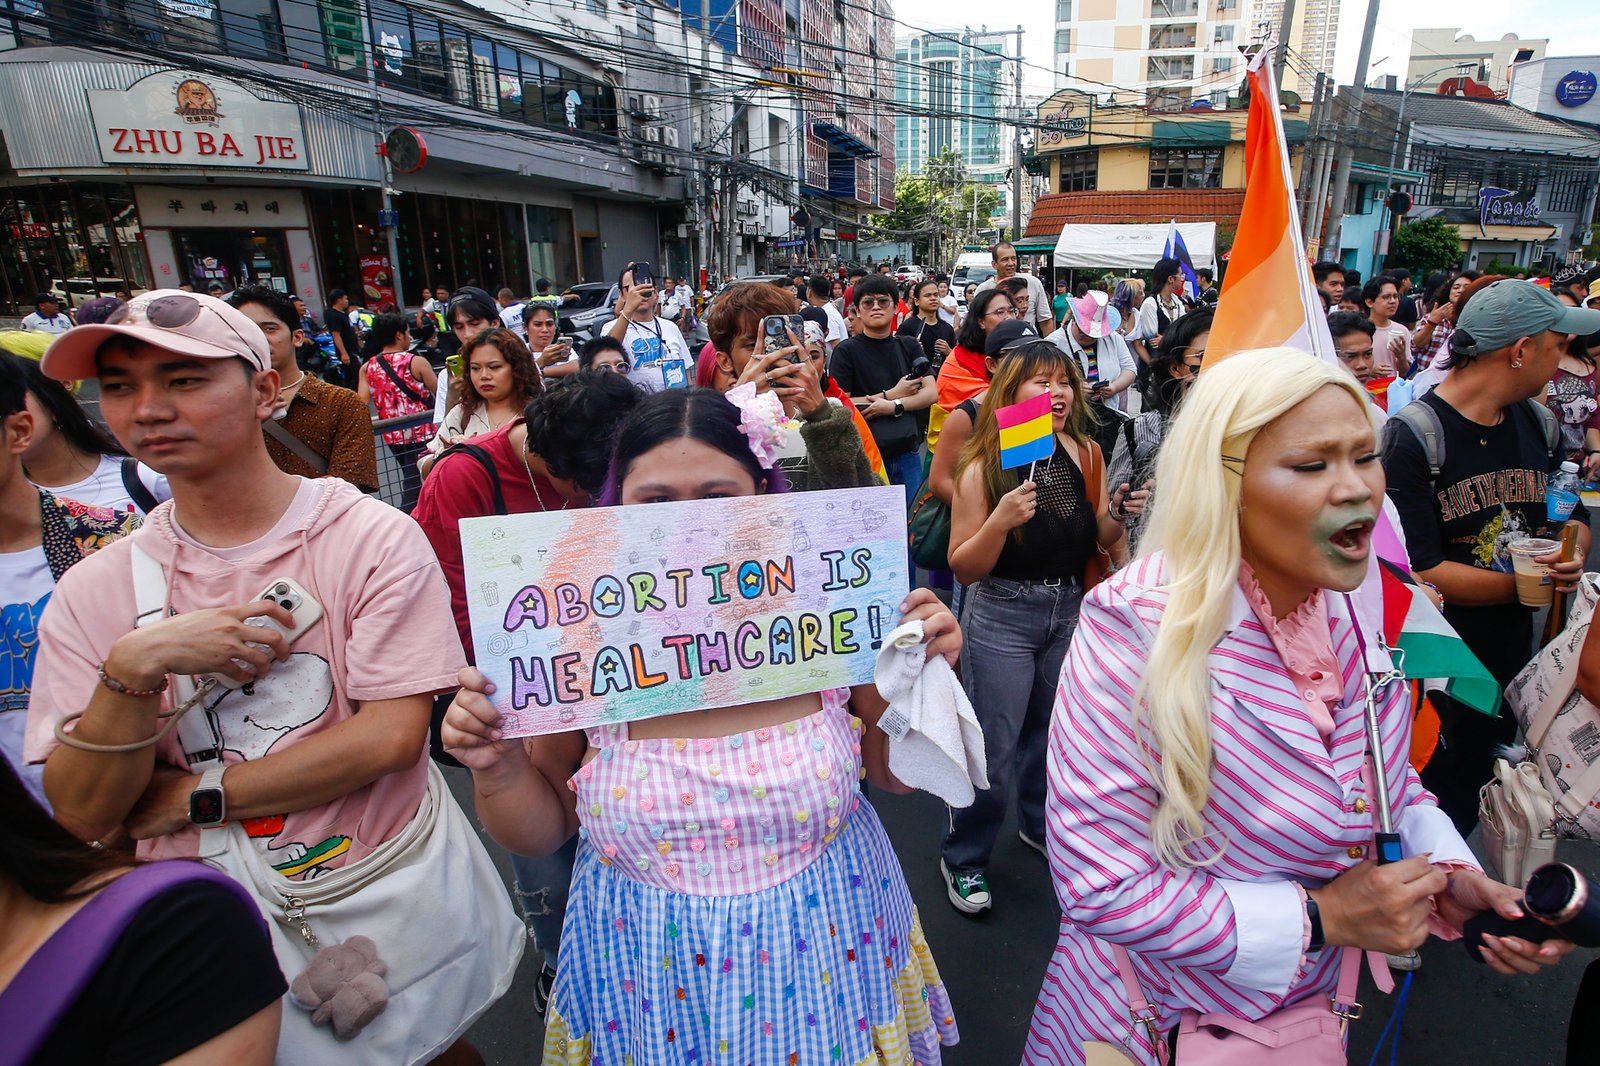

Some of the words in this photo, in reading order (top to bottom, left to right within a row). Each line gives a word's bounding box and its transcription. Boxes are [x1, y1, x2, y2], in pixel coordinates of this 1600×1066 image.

[108, 128, 183, 155] ZHU
[194, 131, 244, 157] BA
[253, 135, 297, 165] JIE
[1437, 478, 1480, 522] SAVE
[1497, 468, 1548, 503] MERMA
[502, 555, 796, 632] ABORTION
[820, 548, 873, 591] IS
[509, 605, 882, 710] HEALTHCARE!
